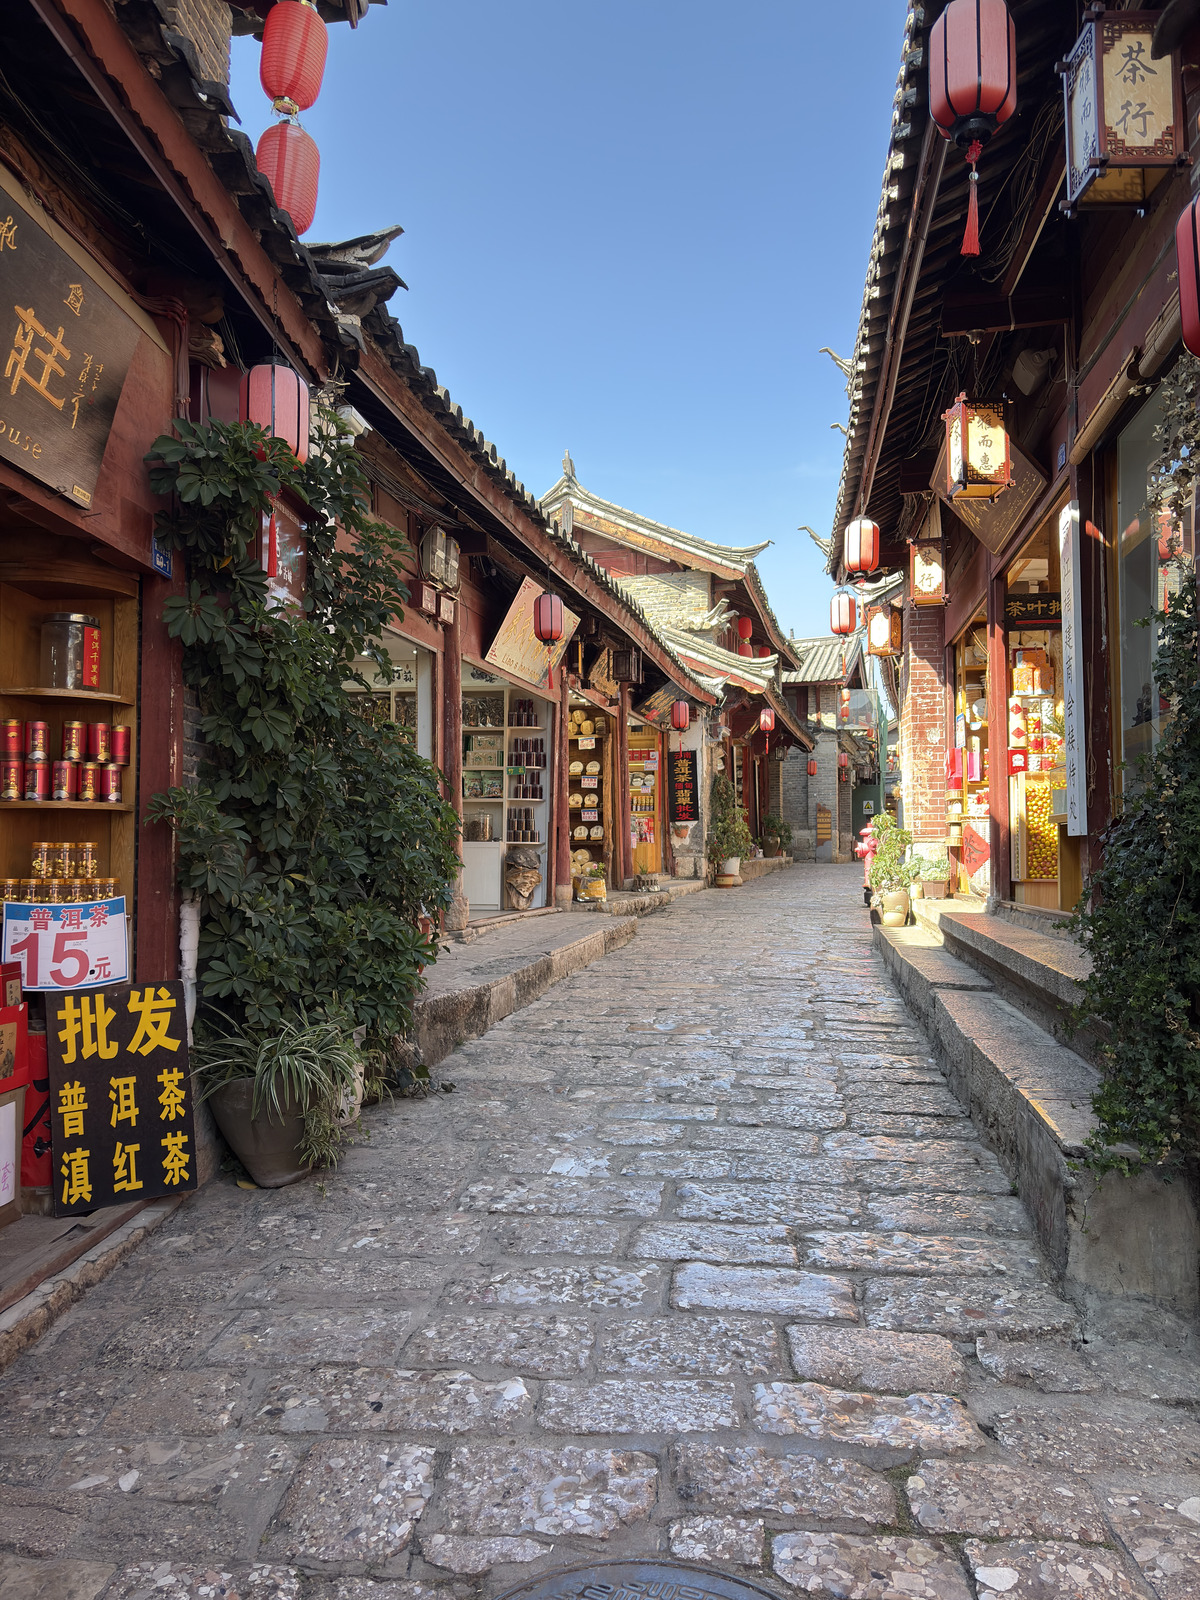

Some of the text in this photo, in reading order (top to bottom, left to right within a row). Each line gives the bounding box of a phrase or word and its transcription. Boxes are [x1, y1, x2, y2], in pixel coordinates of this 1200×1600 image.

[1115, 41, 1158, 138] 茶行
[976, 412, 993, 471] 雅而惠
[919, 549, 936, 588] 茶行
[90, 629, 100, 686] 普洱千里香
[673, 752, 692, 760] 云南
[673, 759, 693, 783] 普洱茶
[674, 782, 693, 790] 缅甸
[674, 789, 694, 805] 翡翠
[675, 805, 695, 821] 批发
[964, 834, 985, 864] 茶
[29, 904, 110, 931] 普洱茶
[57, 986, 181, 1065] 批发
[57, 1067, 186, 1138] 普洱茶
[60, 1130, 190, 1205] 滇红茶
